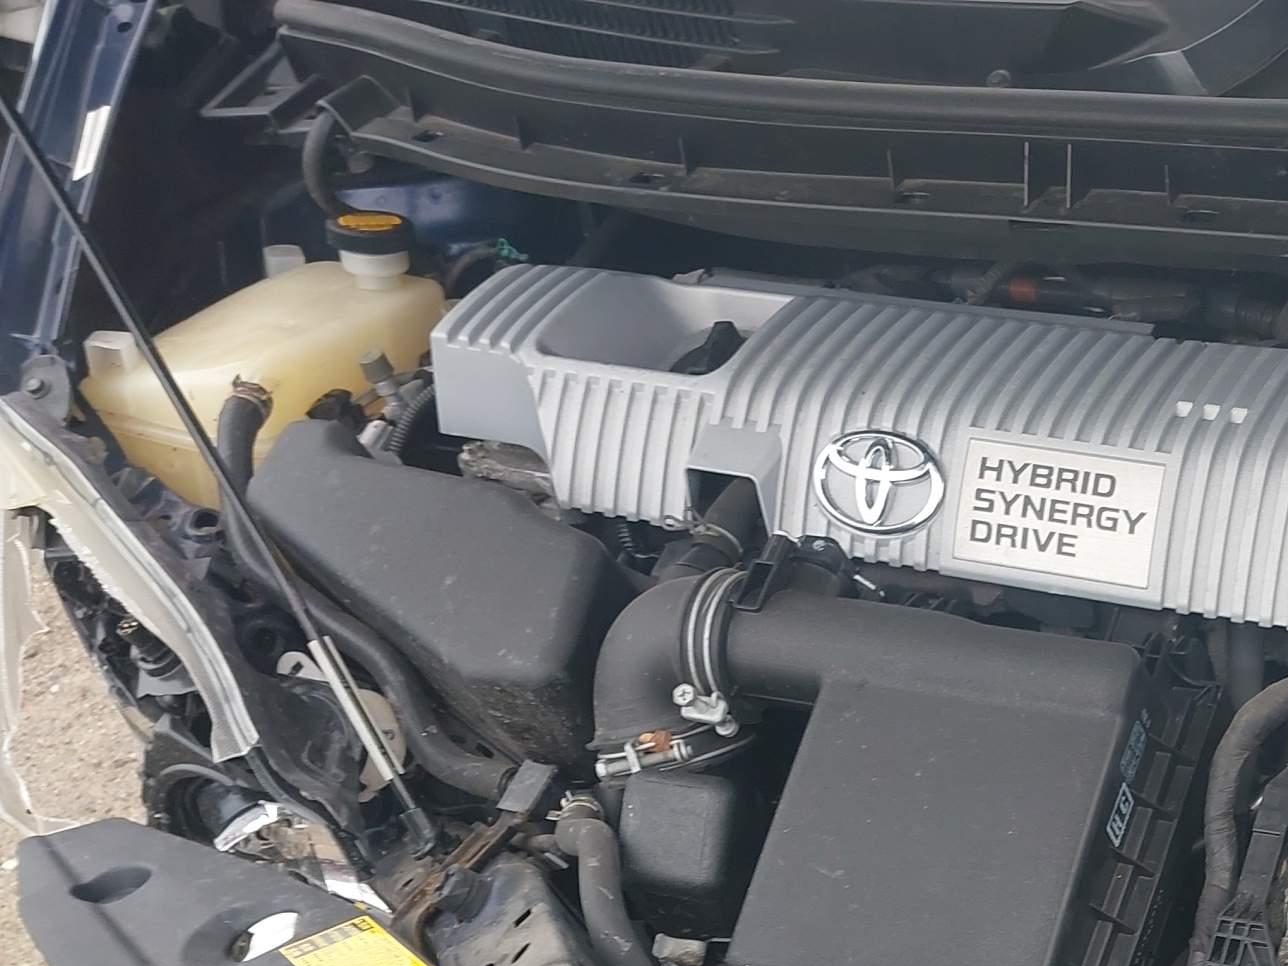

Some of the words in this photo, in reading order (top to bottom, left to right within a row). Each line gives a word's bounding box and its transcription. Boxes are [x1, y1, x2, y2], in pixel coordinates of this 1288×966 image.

[978, 456, 1116, 498] HYBRID
[973, 488, 1147, 536] SYNERGY
[969, 519, 1078, 558] DRIVE
